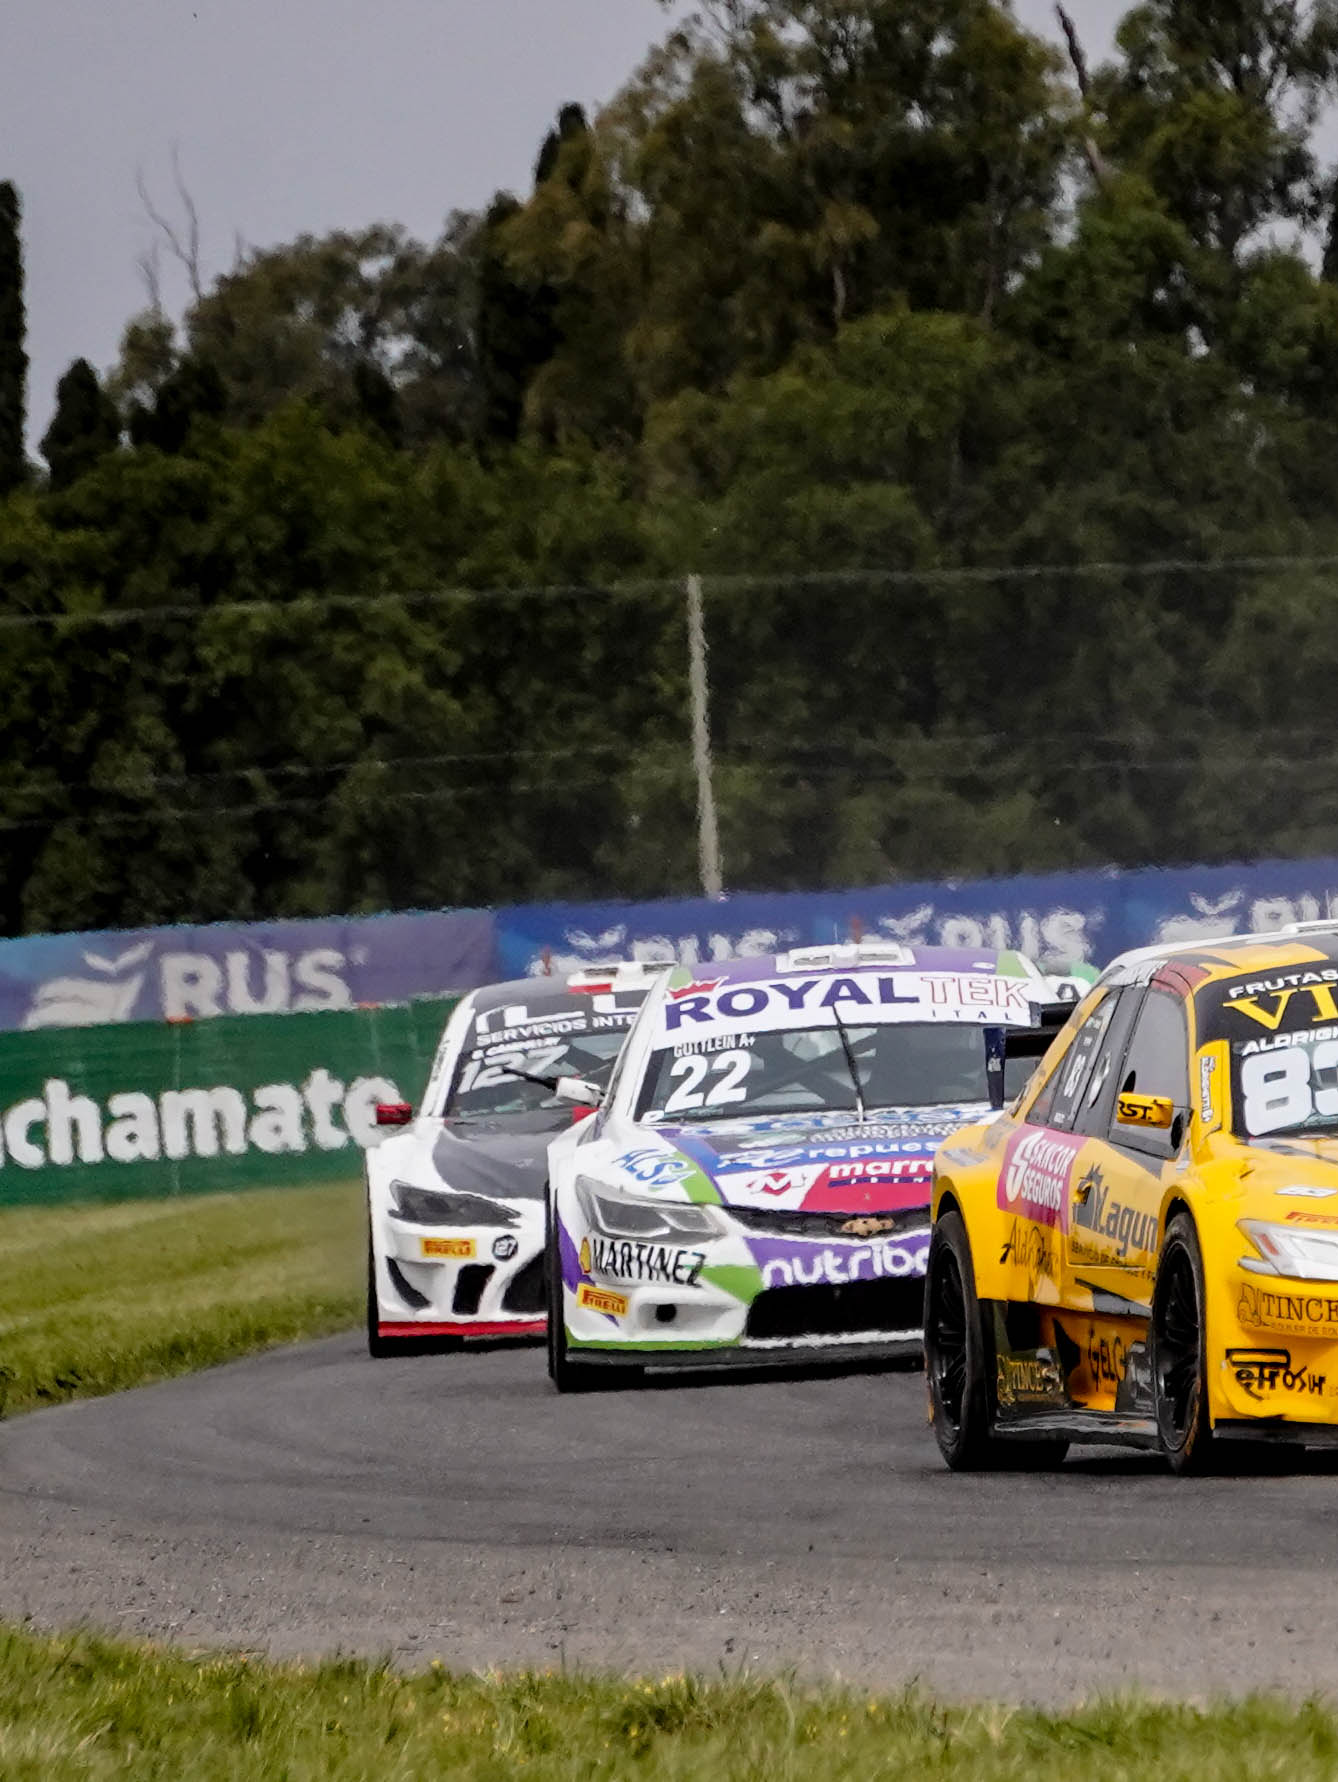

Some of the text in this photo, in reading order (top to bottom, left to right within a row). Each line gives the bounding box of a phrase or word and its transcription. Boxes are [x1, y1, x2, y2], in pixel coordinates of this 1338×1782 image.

[160, 949, 351, 1019] RUS
[664, 976, 919, 1030] ROYAL
[920, 976, 1031, 1009] TEK
[477, 1018, 587, 1047] SERVICIOS
[457, 1044, 570, 1095] 127
[664, 1050, 751, 1114] 22
[0, 1067, 404, 1170] chamate
[1029, 1132, 1076, 1177] SANCOR
[1021, 1170, 1064, 1210] SEGUROS
[424, 1240, 471, 1256] PIRELLI
[592, 1238, 707, 1287] MARTINEZ
[582, 1289, 626, 1315] PIRELLI
